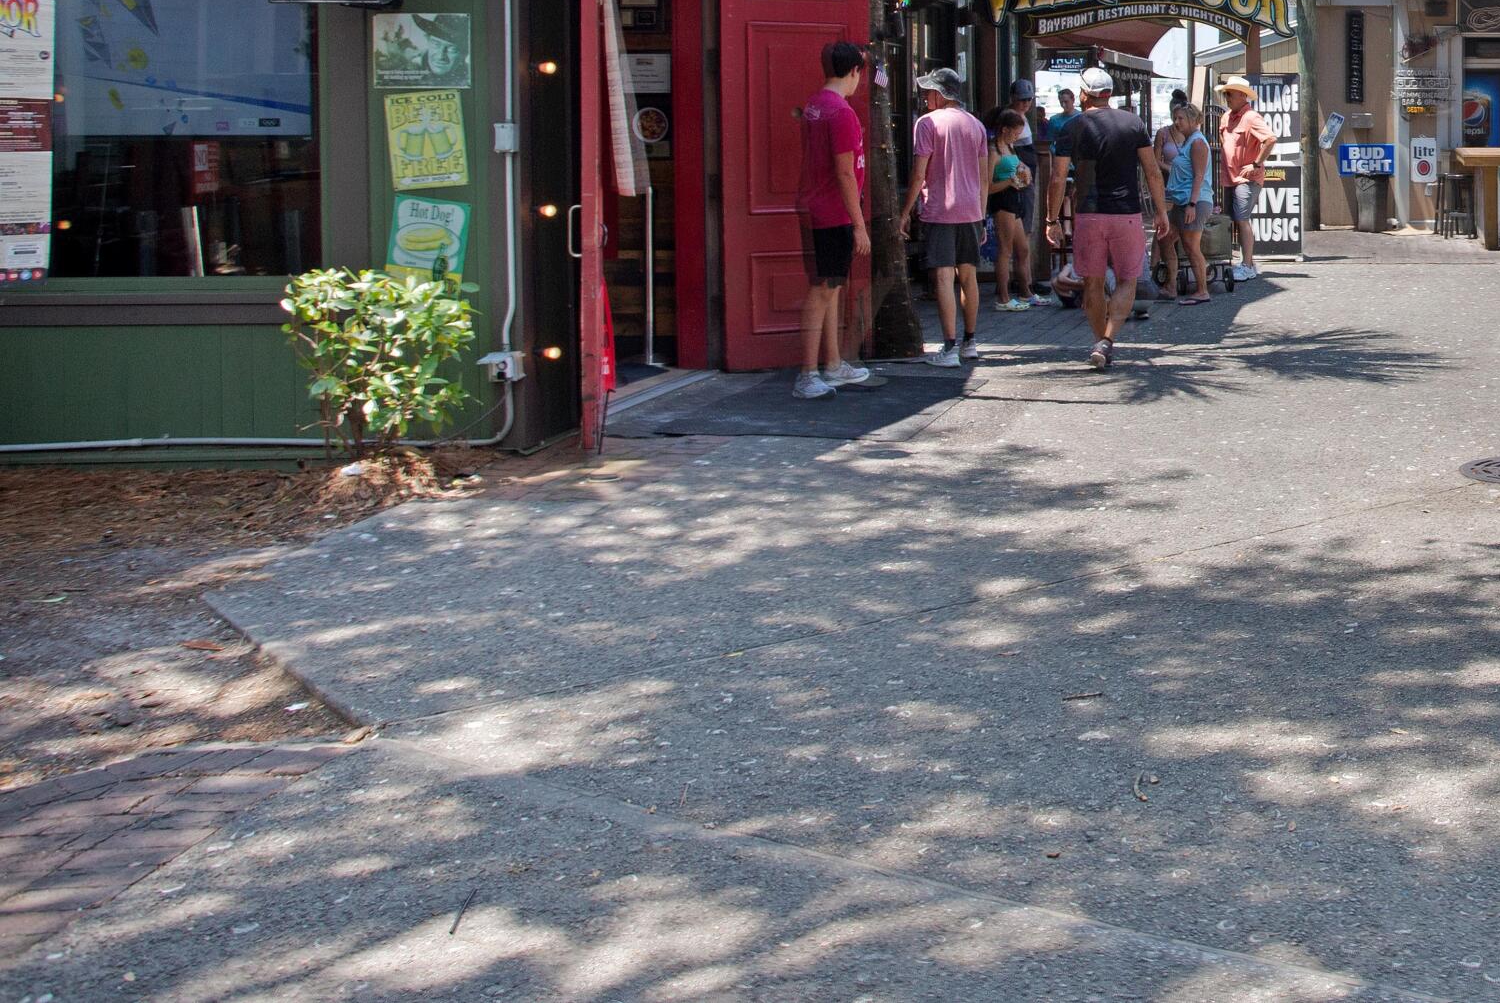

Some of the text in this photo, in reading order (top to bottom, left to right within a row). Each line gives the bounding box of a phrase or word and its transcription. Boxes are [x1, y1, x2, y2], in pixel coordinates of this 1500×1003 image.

[1038, 4, 1243, 37] BAYFRONT RESTAURANT & NIGHTCLUB
[390, 93, 456, 105] ICE COLD
[1251, 83, 1299, 113] ILLAGE
[390, 101, 460, 130] BEER
[394, 149, 465, 178] FREE
[1348, 146, 1385, 160] BUD
[1413, 146, 1435, 160] Lite
[1341, 159, 1392, 173] LIGHT
[409, 202, 455, 226] Hot Dog!
